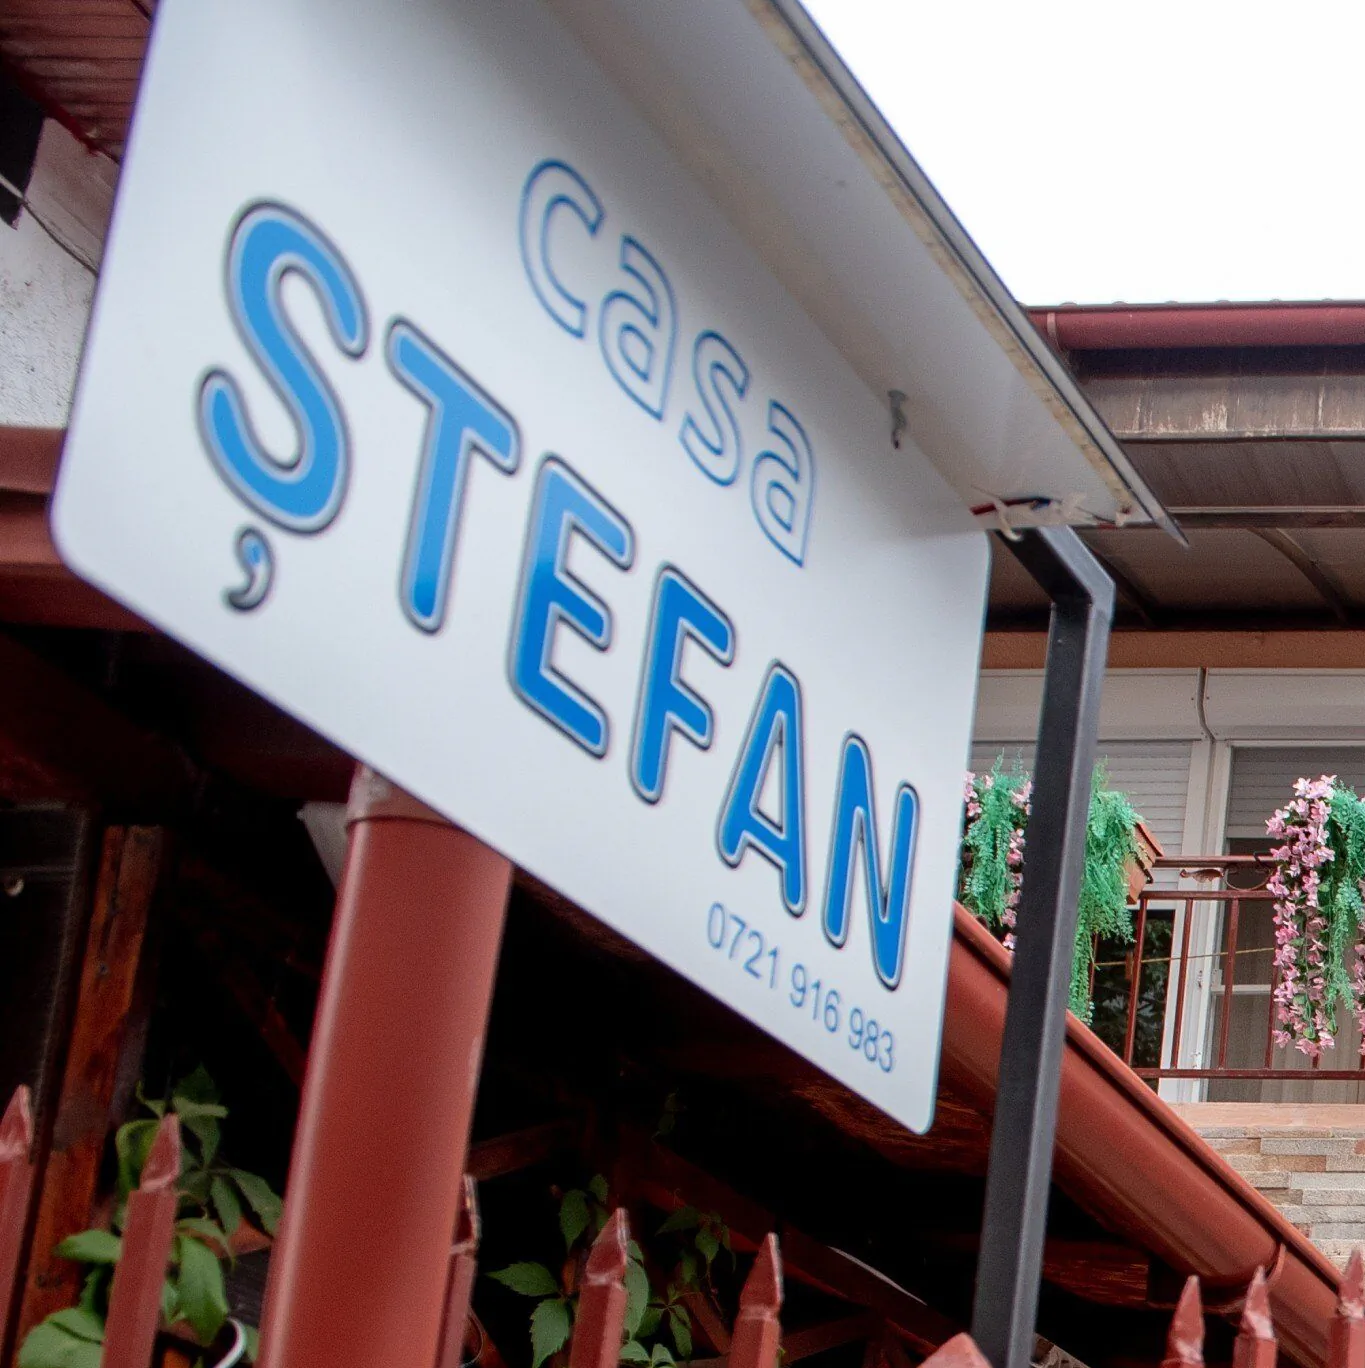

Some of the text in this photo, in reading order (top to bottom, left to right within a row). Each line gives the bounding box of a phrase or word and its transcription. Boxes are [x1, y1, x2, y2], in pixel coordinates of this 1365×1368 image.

[519, 159, 817, 568] casa
[707, 902, 893, 1072] 0721 916 983
